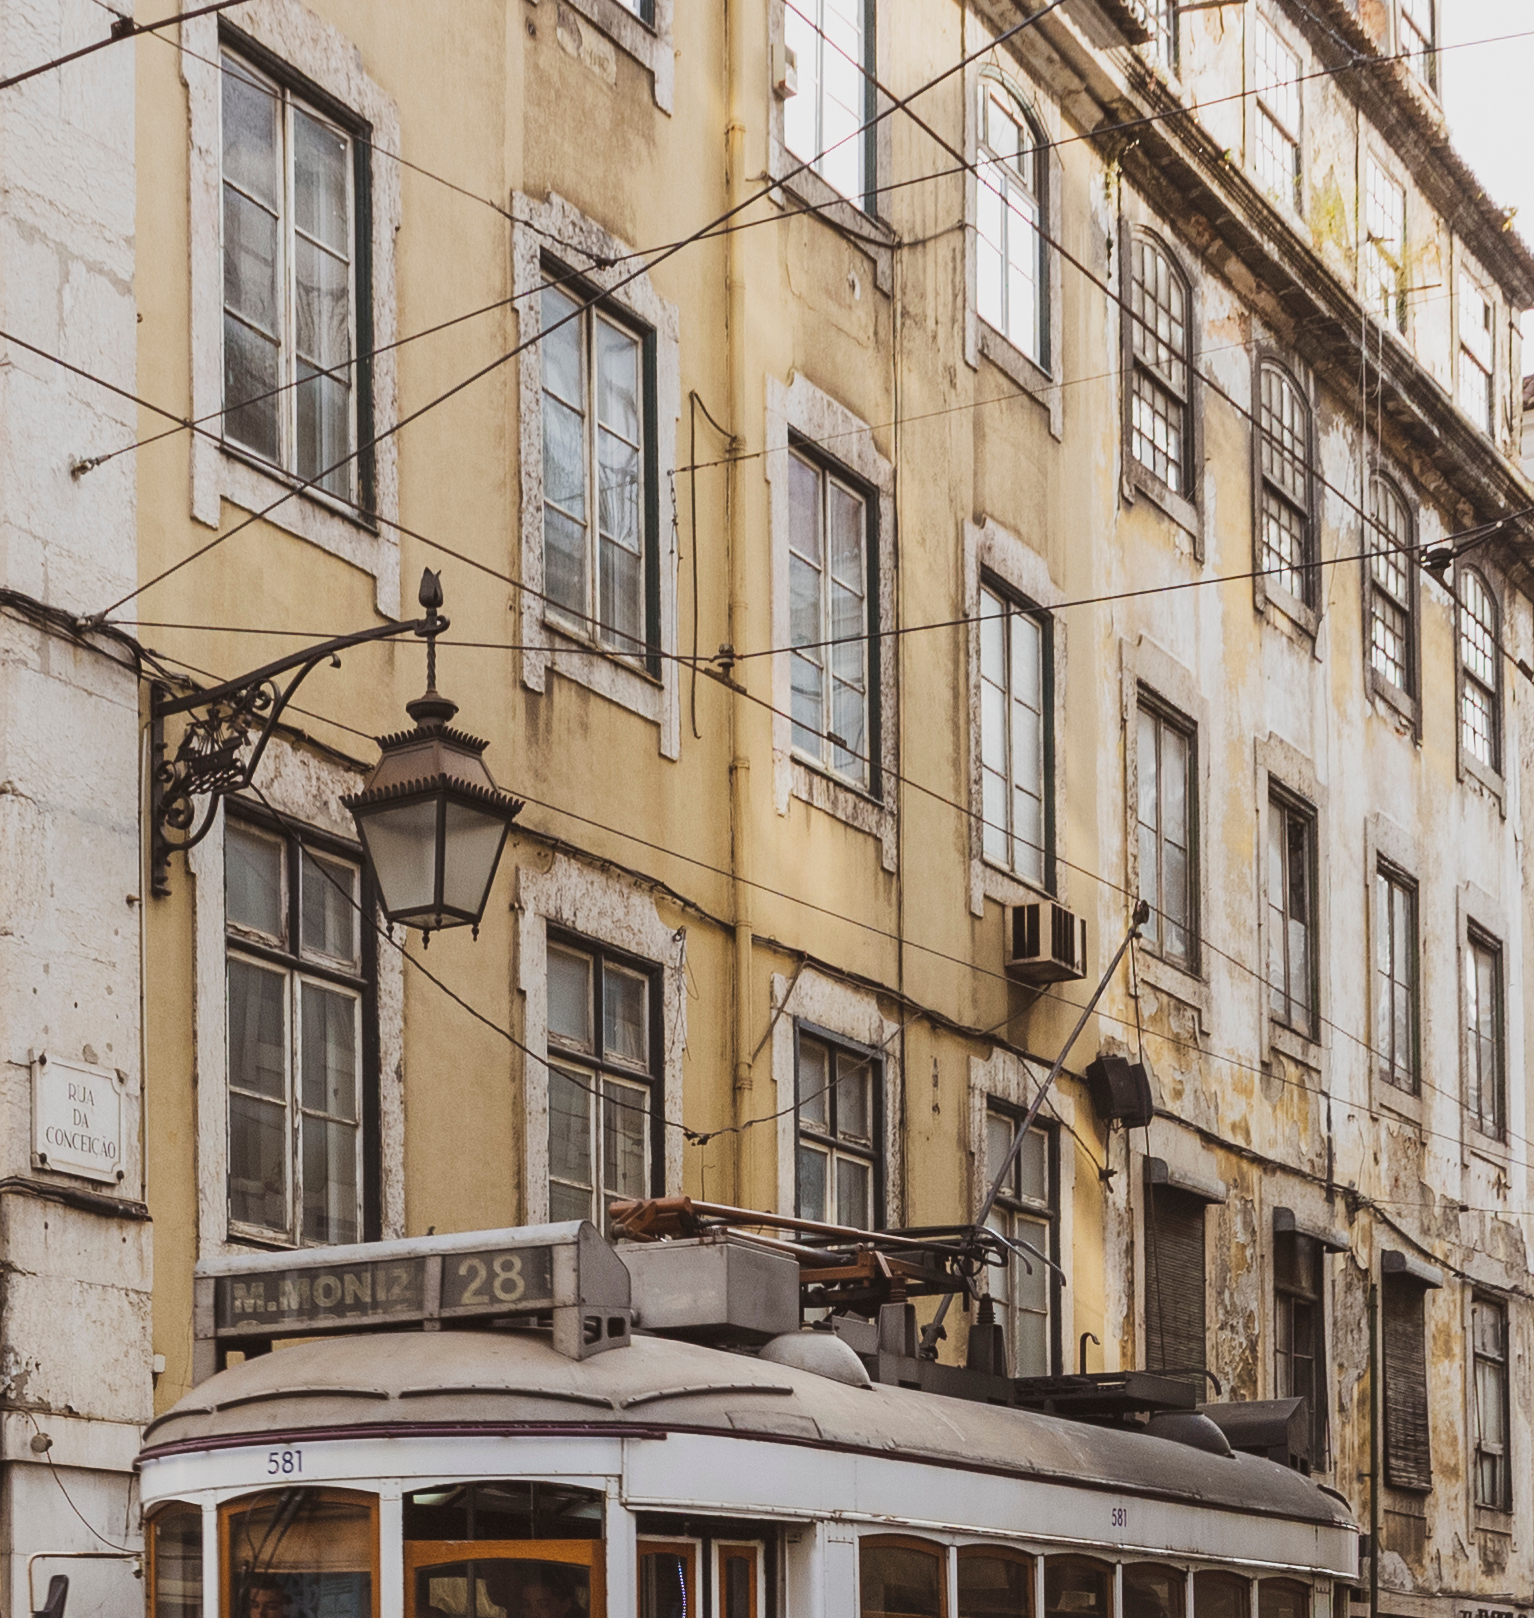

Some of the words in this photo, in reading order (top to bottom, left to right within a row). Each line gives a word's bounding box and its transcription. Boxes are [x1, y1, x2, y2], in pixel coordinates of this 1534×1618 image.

[68, 1082, 94, 1106] RUA
[73, 1108, 89, 1128] DA
[46, 1126, 116, 1159] CONCEIÇÃO
[458, 1254, 525, 1305] 28
[268, 1450, 302, 1474] 581
[1112, 1508, 1127, 1527] 581
